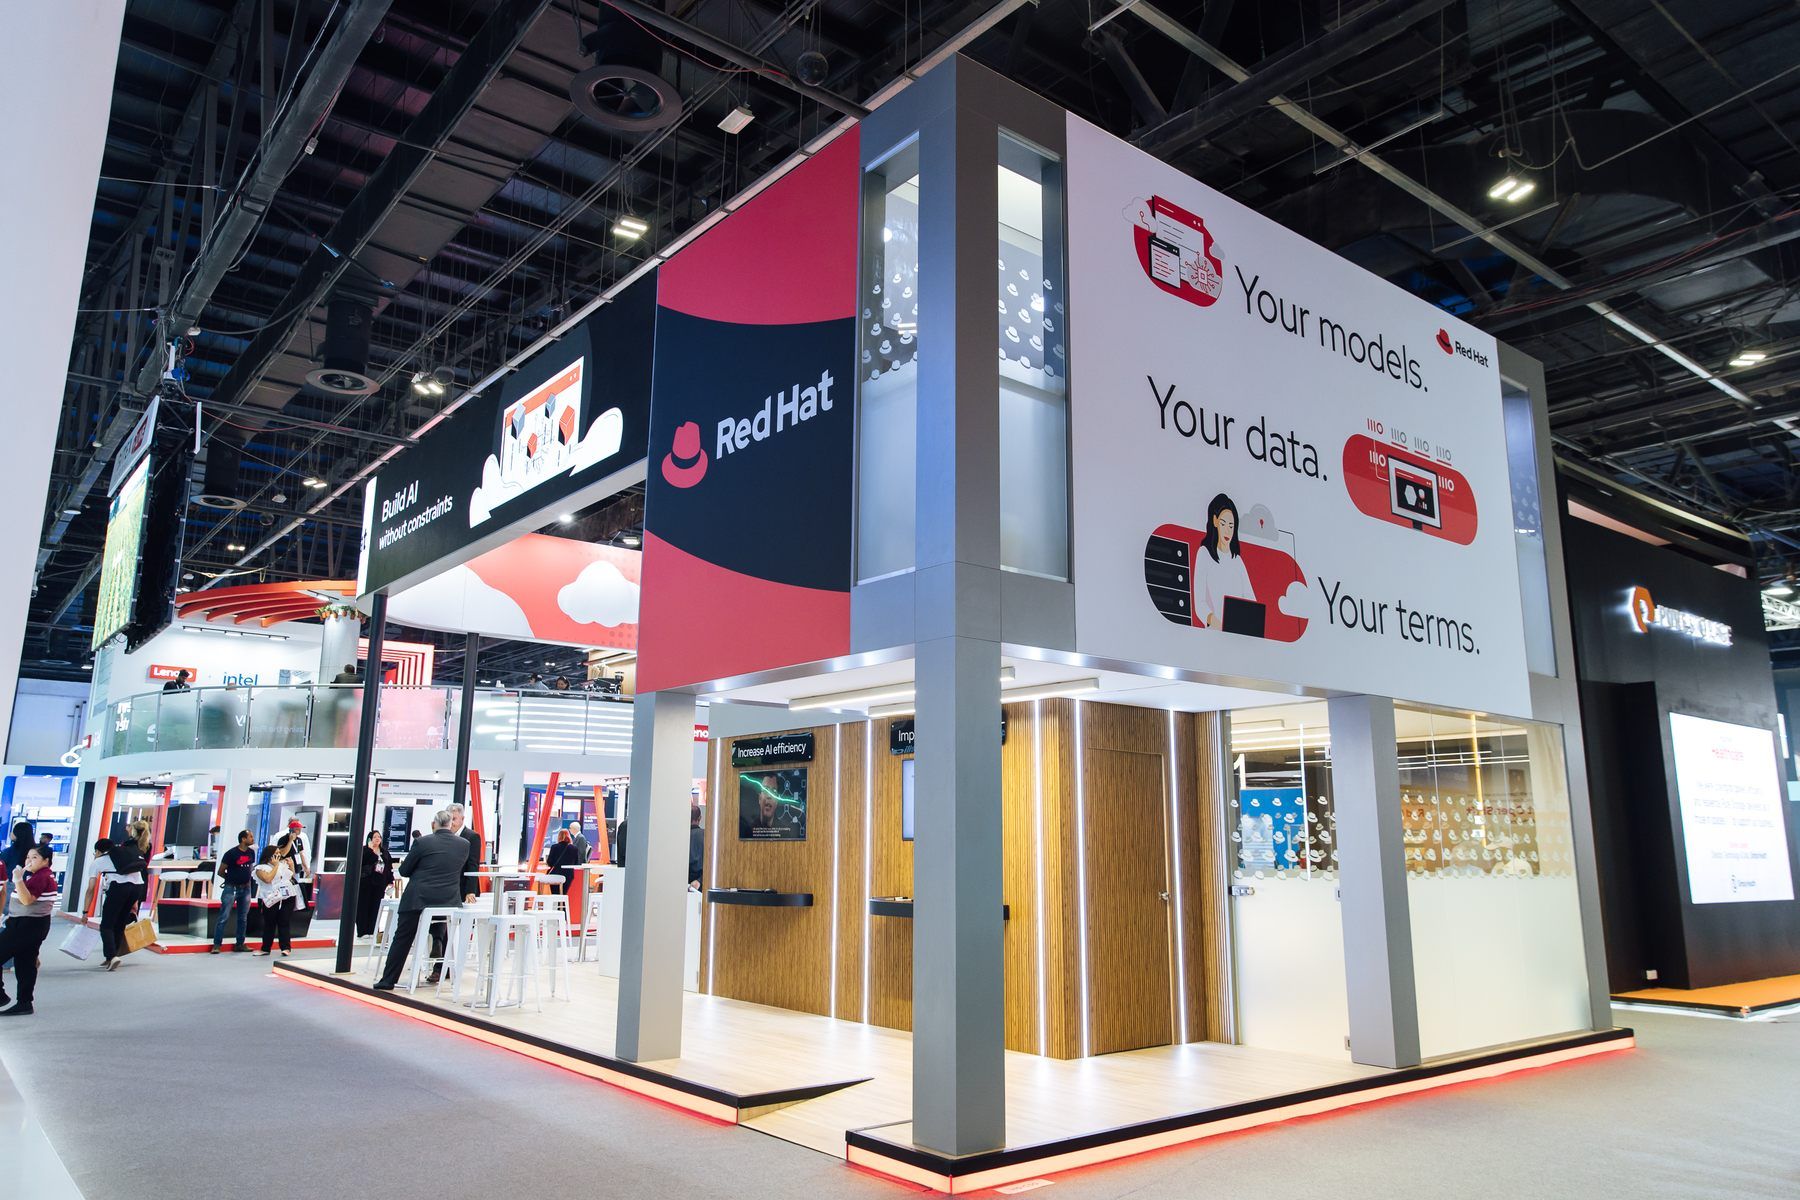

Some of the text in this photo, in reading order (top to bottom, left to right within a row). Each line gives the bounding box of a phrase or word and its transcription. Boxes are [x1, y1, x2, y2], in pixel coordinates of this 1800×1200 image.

[1235, 265, 1428, 392] Your models.
[1455, 340, 1489, 368] Red Hat
[716, 369, 834, 460] Red Hat
[1147, 375, 1328, 482] Your data.
[379, 520, 408, 550] without
[407, 495, 453, 534] constraints
[382, 480, 419, 523] Build AI
[1318, 576, 1480, 655] Your terms.
[223, 672, 258, 686] intel
[737, 742, 806, 758] Increase AI efficiency
